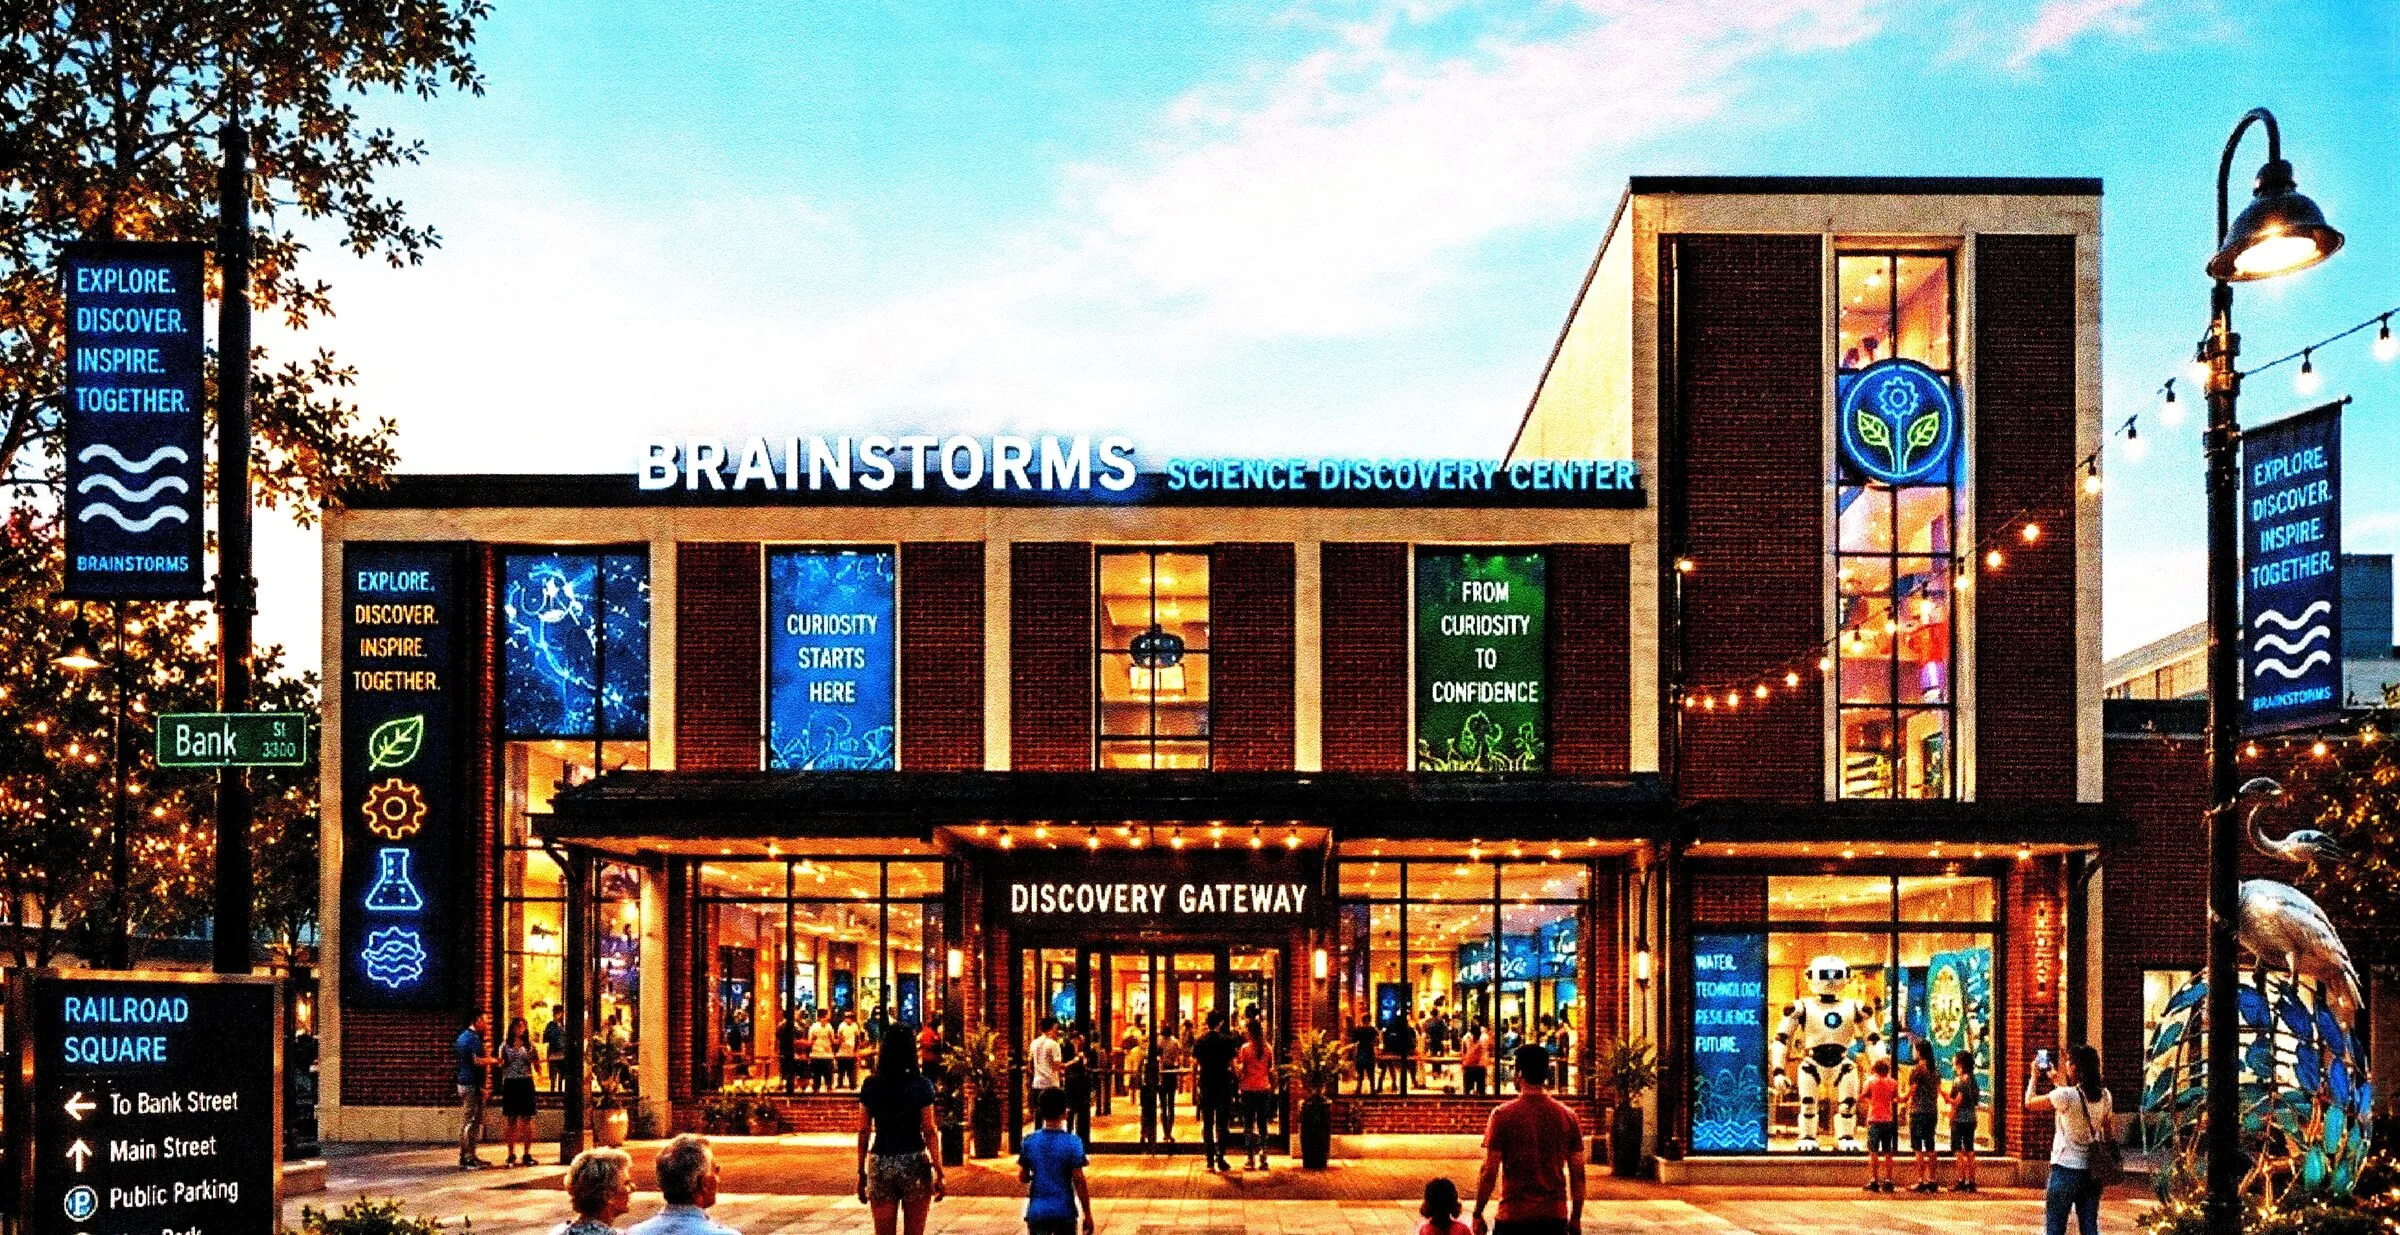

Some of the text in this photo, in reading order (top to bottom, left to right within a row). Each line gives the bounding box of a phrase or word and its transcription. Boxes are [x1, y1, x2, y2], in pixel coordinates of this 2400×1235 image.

[76, 267, 176, 293] EXPLORE.
[76, 307, 188, 333] DISCOVER.
[76, 347, 167, 374] INSPIRE.
[75, 387, 190, 413] TOGETHER.
[638, 435, 1138, 491] BRAINSTORMS
[1166, 458, 1637, 491] SCIENCE DISCOVERY CENTER
[2254, 446, 2328, 486] EXPLORE.
[2252, 479, 2333, 522] DISCOVER.
[2260, 517, 2325, 552] INSPIRE.
[77, 555, 189, 572] BRAINSTORMS
[2251, 551, 2334, 589] TOGETHER.
[358, 571, 436, 592] EXPLORE.
[1462, 581, 1509, 603] FROM
[355, 604, 439, 625] DISCOVER.
[786, 613, 878, 636] CURIOSITY
[1440, 614, 1531, 636] CURIOSITY
[360, 637, 428, 657] INSPIRE.
[798, 646, 866, 670] STARTS
[1474, 647, 1498, 670] TO
[352, 670, 441, 692] TOGETHER.
[809, 680, 856, 703] HERE
[1432, 681, 1539, 703] CONFIDENCE
[176, 720, 287, 758] Bank St
[1011, 883, 1308, 914] DISCOVERY GATEWAY
[1695, 953, 1737, 971] WATER.
[64, 996, 189, 1023] RAILROAD
[64, 1036, 167, 1064] SQUARE
[110, 1090, 239, 1116] To Bank Street
[109, 1135, 217, 1163] Main Street
[109, 1178, 239, 1210] Public Parking
